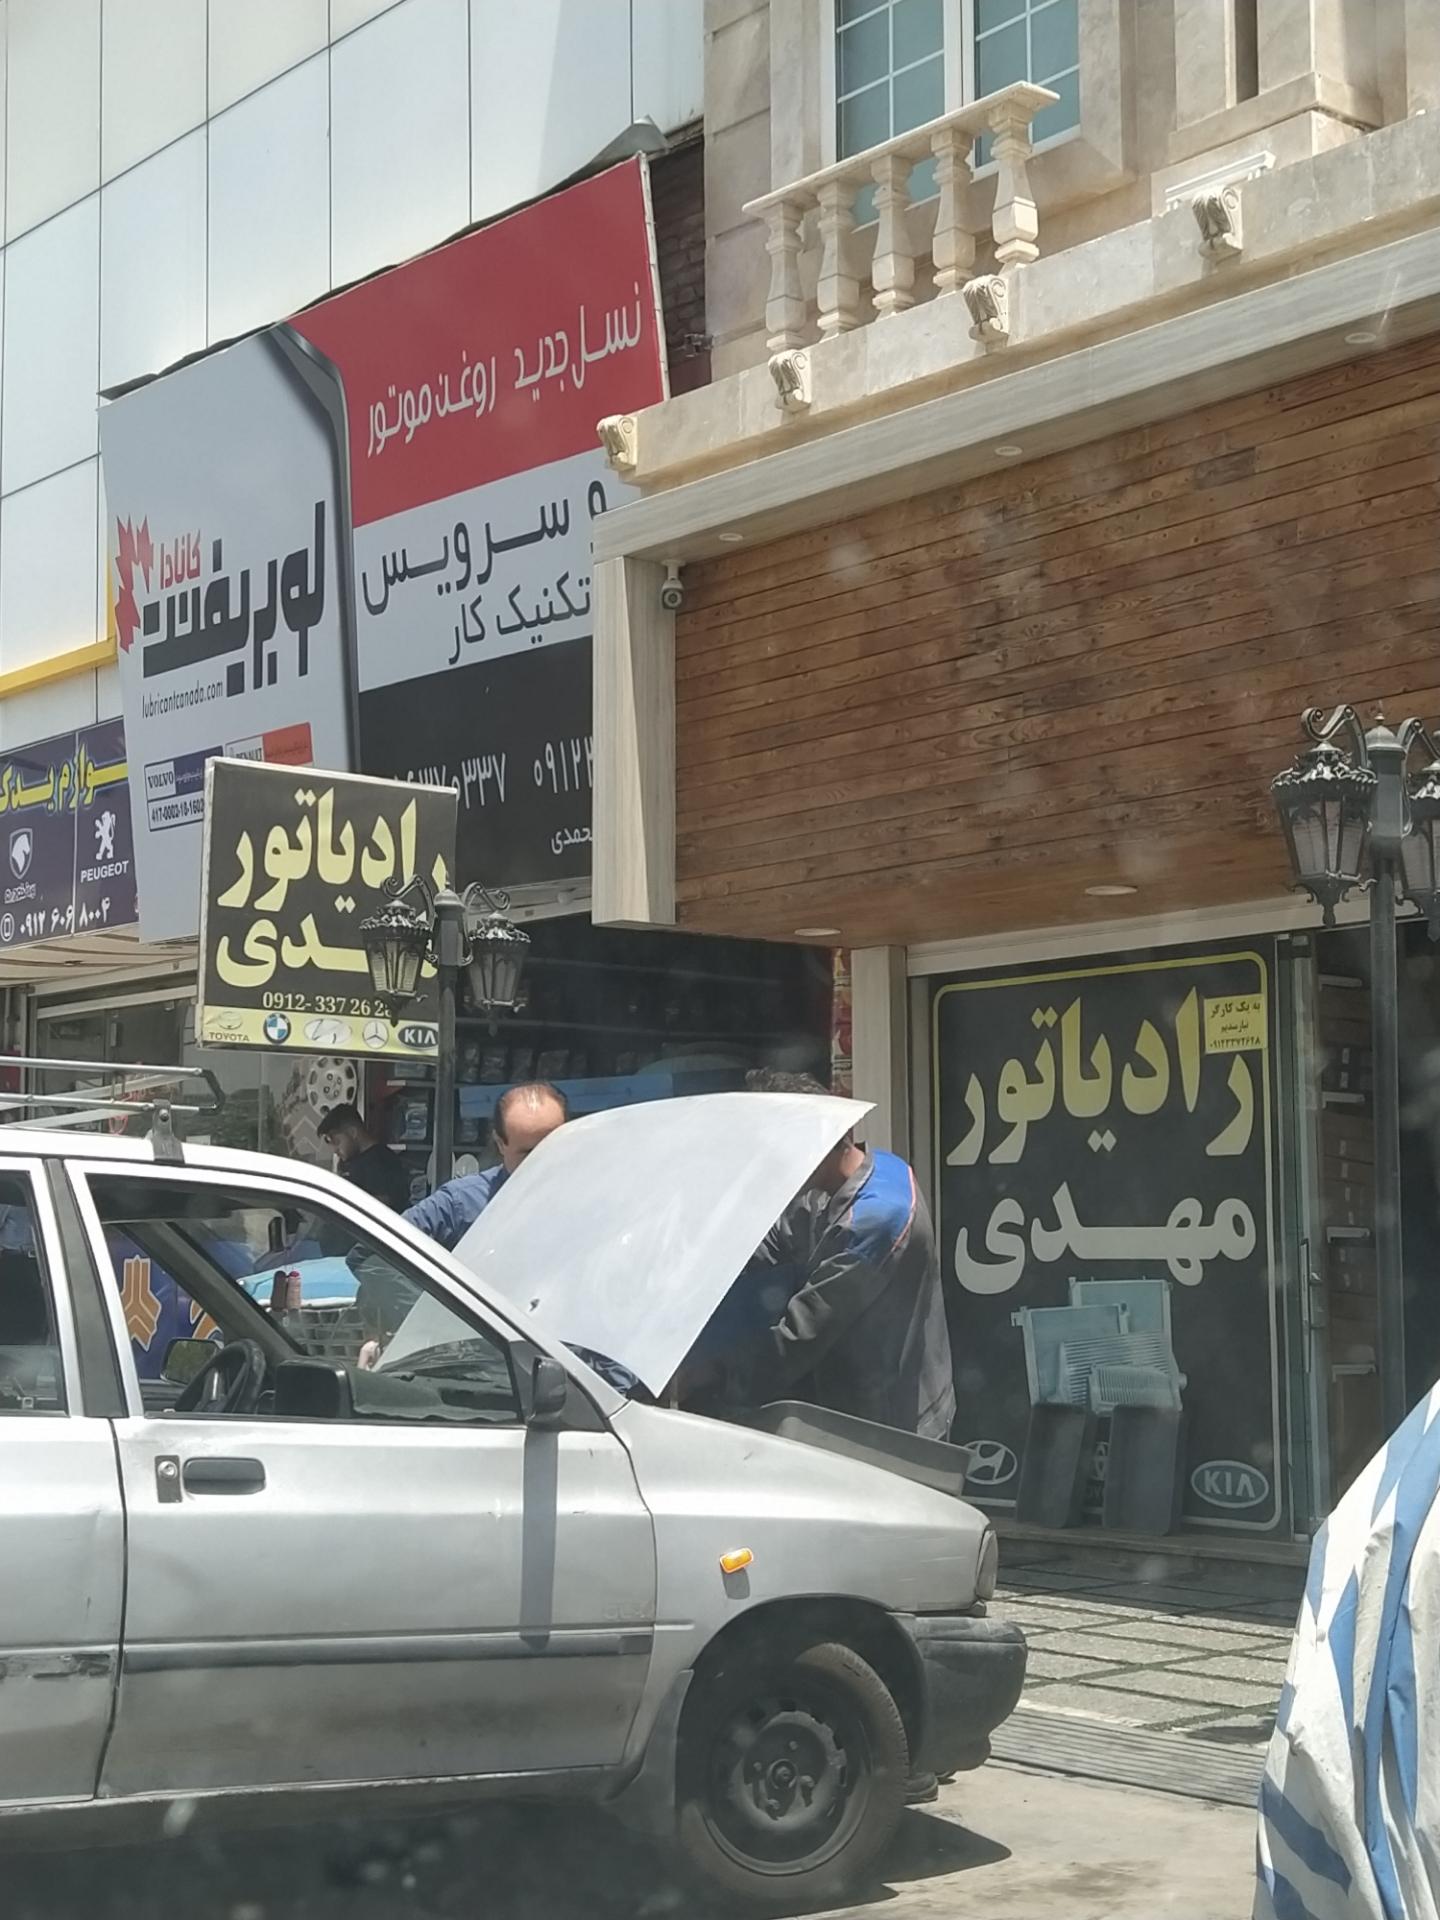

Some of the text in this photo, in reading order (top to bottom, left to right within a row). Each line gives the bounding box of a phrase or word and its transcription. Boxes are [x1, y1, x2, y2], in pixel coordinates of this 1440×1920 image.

[514, 281, 641, 402] نسل جدید
[367, 350, 496, 458] روغن موتور
[362, 498, 570, 616] سرویس
[449, 570, 591, 665] تکنیک کار
[0, 743, 128, 813] وازم یدک
[147, 771, 174, 789] VOLVO
[551, 827, 592, 855] حمدی
[80, 860, 129, 883] PEUGEOT
[315, 997, 346, 1014] 337
[350, 999, 371, 1016] 26
[208, 1031, 250, 1043] TOYOTA
[404, 1027, 437, 1044] KIA
[946, 986, 1255, 1167] رادیاتور
[954, 1181, 1257, 1295] مهدی
[1204, 1470, 1256, 1499] KIA
